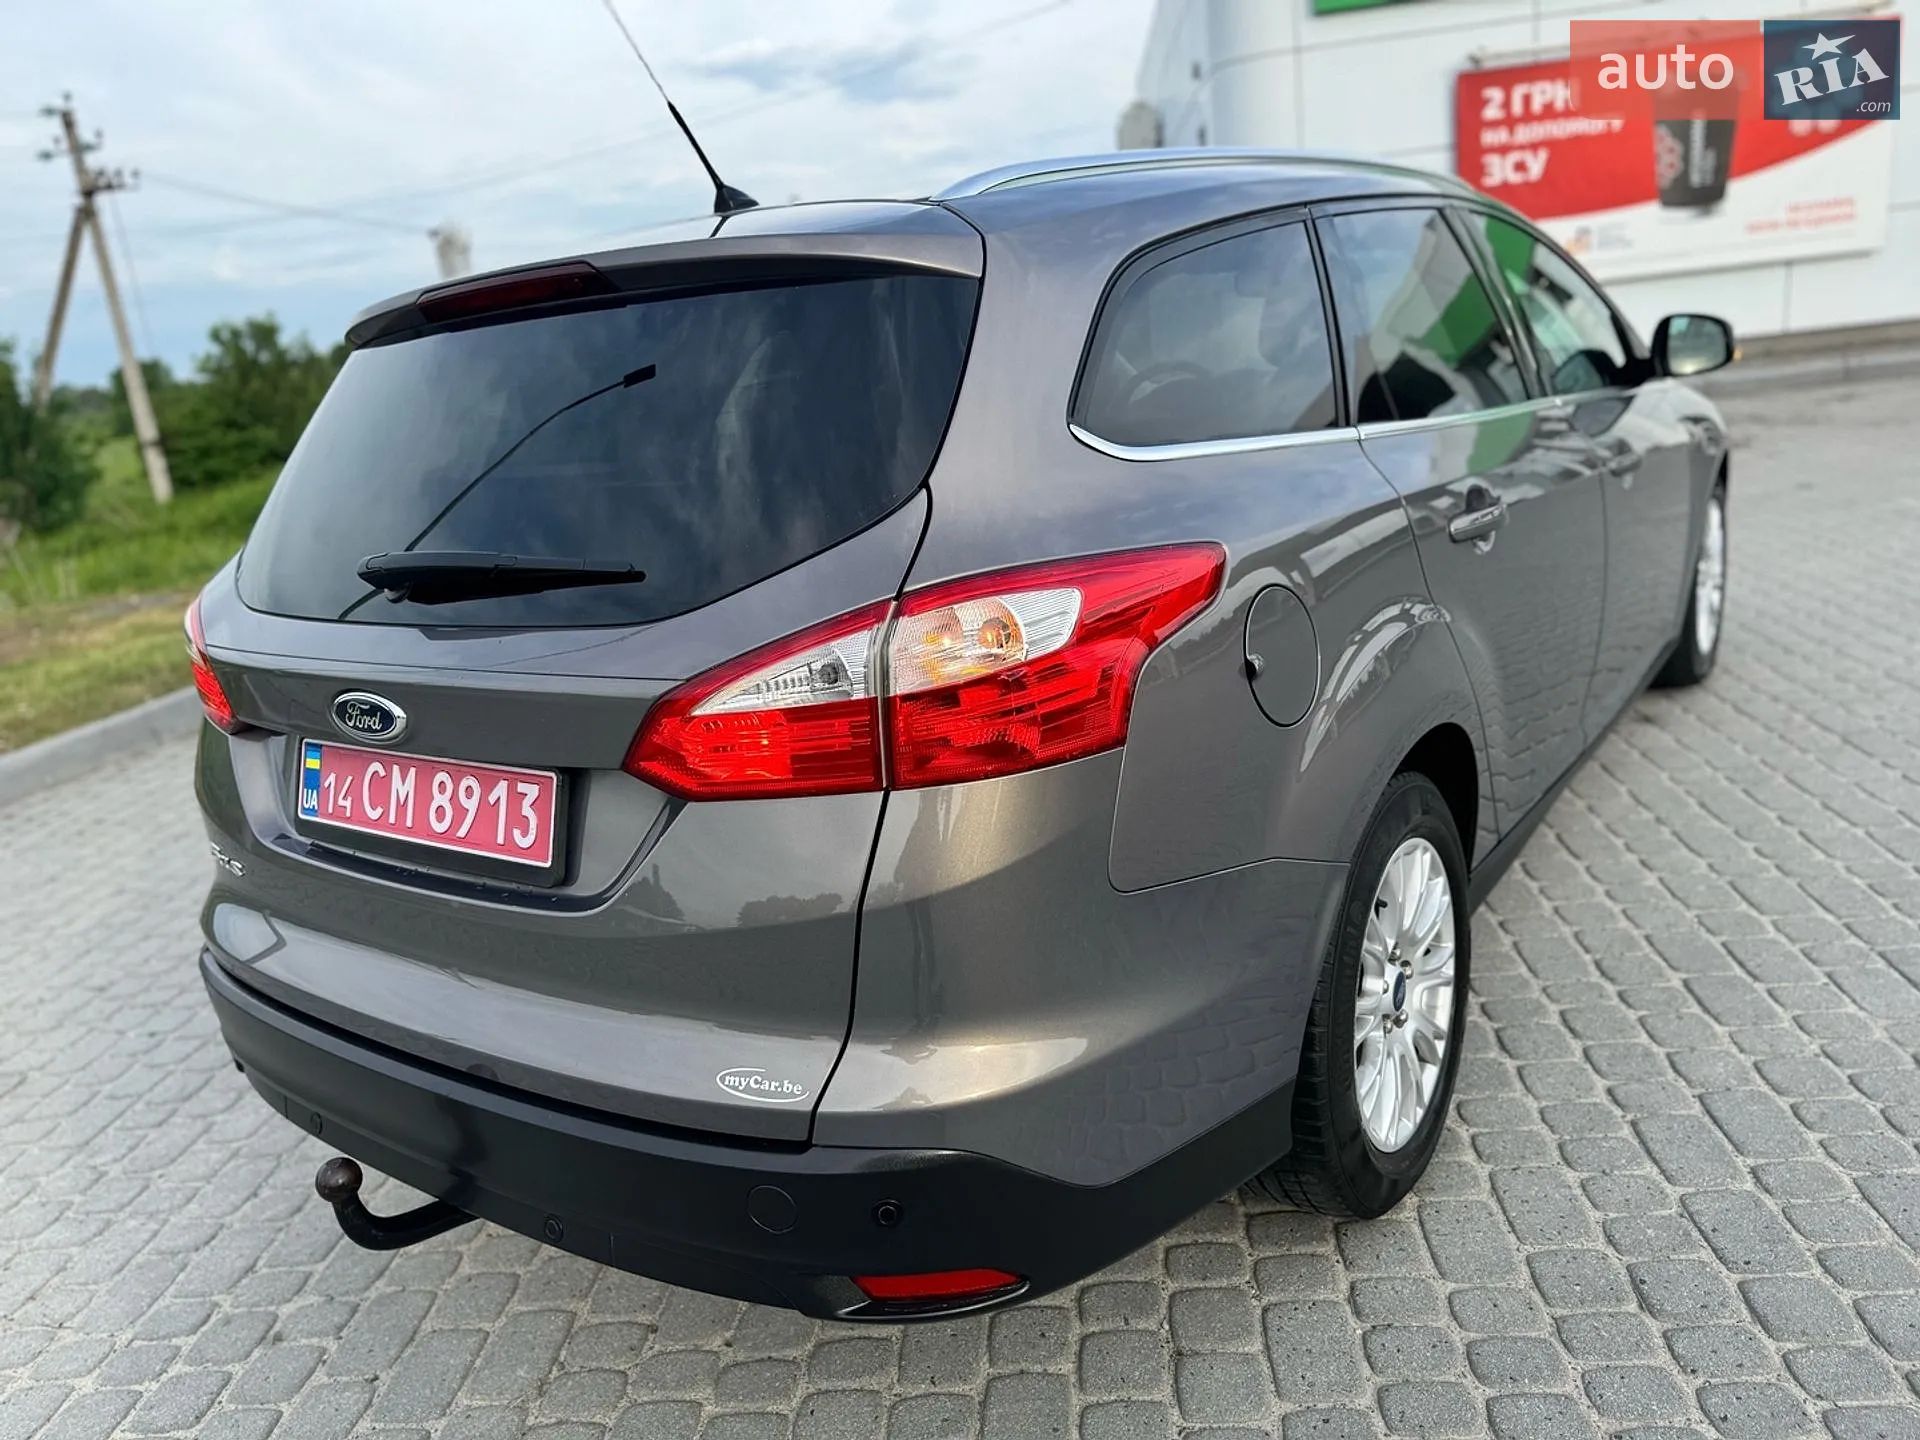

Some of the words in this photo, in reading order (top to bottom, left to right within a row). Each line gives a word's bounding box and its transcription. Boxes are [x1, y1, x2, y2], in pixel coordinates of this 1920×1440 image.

[1480, 86, 1506, 121] 2
[345, 701, 383, 730] Ford
[303, 788, 319, 811] UA
[323, 771, 353, 818] 14
[362, 760, 416, 829] CM
[428, 770, 541, 850] 8913
[724, 1074, 803, 1095] myCar.be
